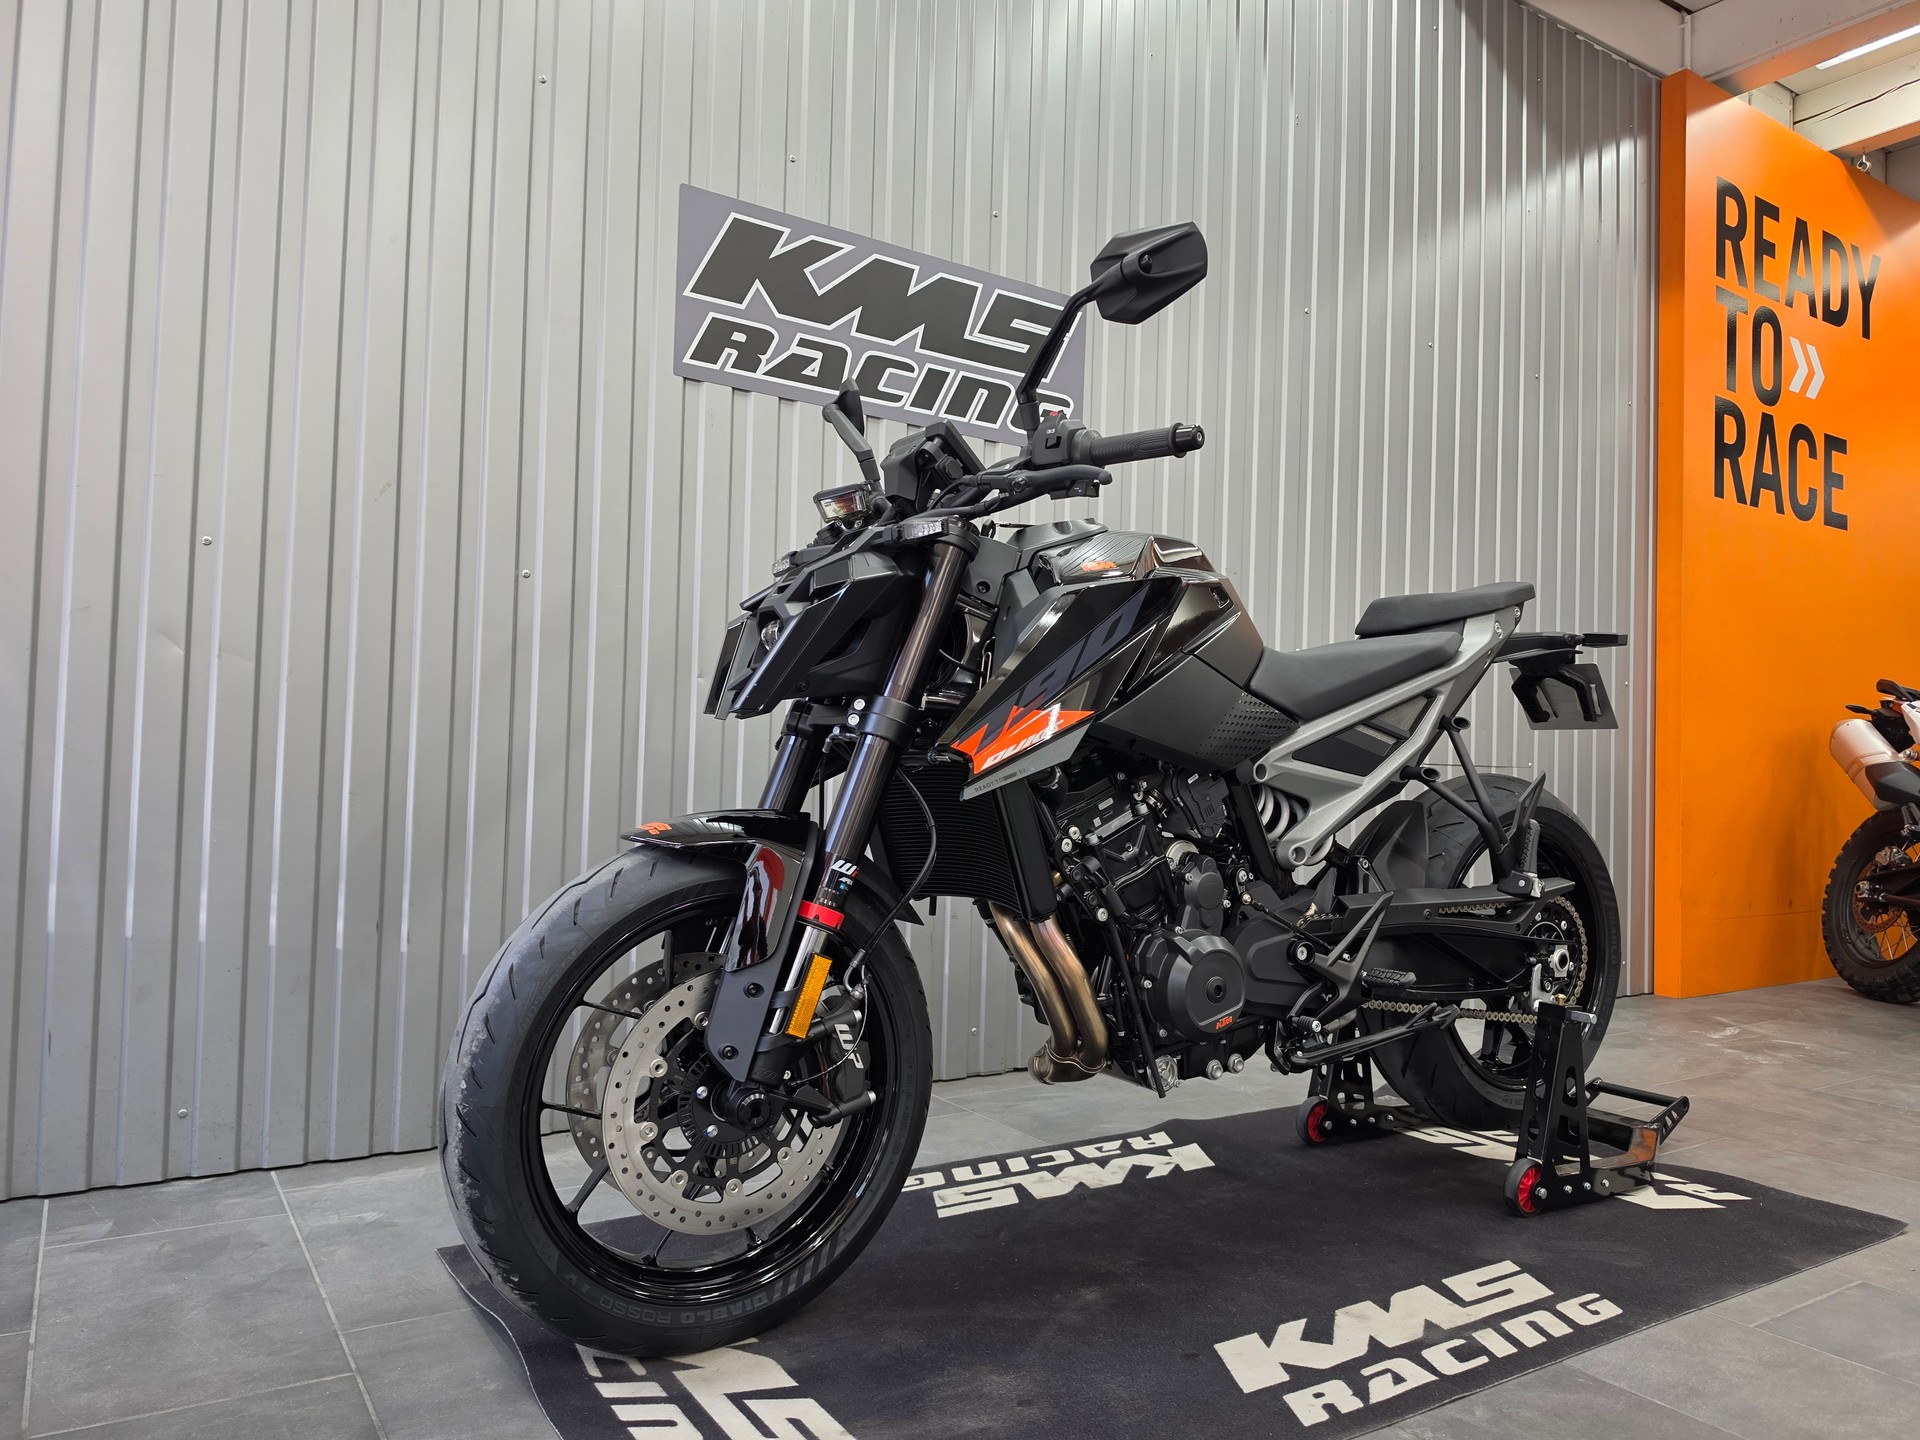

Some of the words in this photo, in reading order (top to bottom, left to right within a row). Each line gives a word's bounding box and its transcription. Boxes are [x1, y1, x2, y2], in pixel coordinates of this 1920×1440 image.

[684, 212, 1082, 382] KMS
[1715, 176, 1881, 341] READY
[1716, 286, 1783, 407] TO
[1714, 395, 1849, 531] RACE
[974, 779, 996, 793] READY
[933, 1142, 1216, 1218] KMS
[1213, 1260, 1555, 1394] KMS
[1282, 1292, 1624, 1427] RACING
